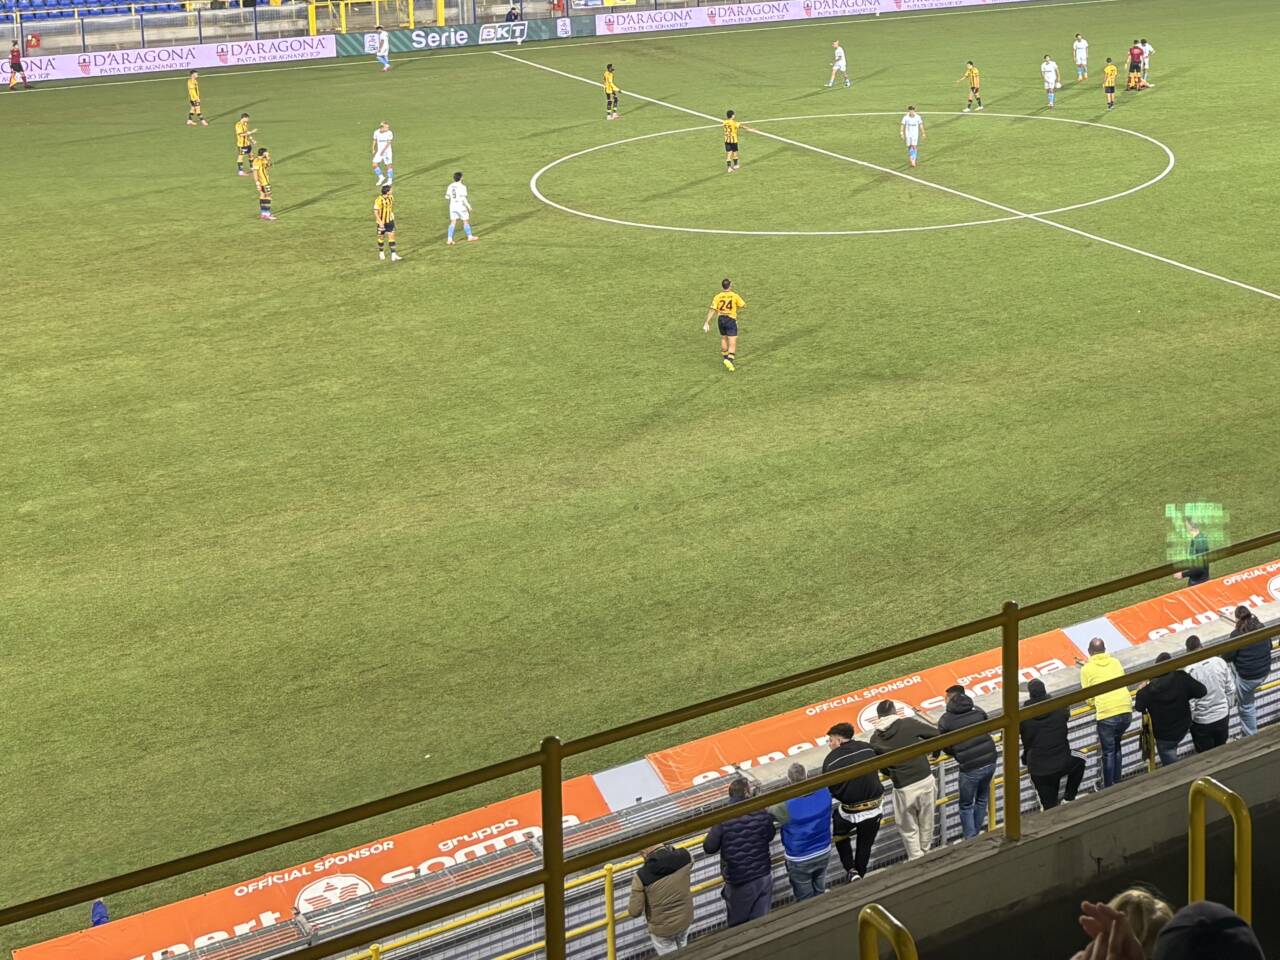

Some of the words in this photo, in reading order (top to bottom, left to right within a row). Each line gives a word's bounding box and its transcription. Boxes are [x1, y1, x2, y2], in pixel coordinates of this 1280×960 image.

[616, 10, 692, 26] D'ARAGONA
[718, 2, 790, 18] D'ARAGONA
[412, 27, 469, 48] Serie
[481, 24, 527, 41] BKT
[231, 37, 326, 56] D'ARAGONA
[94, 47, 196, 67] D'ARAGONA
[100, 66, 121, 74] PASTA
[719, 299, 733, 311] 24
[1223, 569, 1267, 586] OFFICIAL
[805, 695, 862, 716] OFFICIAL
[863, 675, 922, 699] SPONSOR
[437, 818, 519, 852] gruppo
[233, 867, 311, 897] OFFICIAL
[313, 840, 394, 873] SPONSOR
